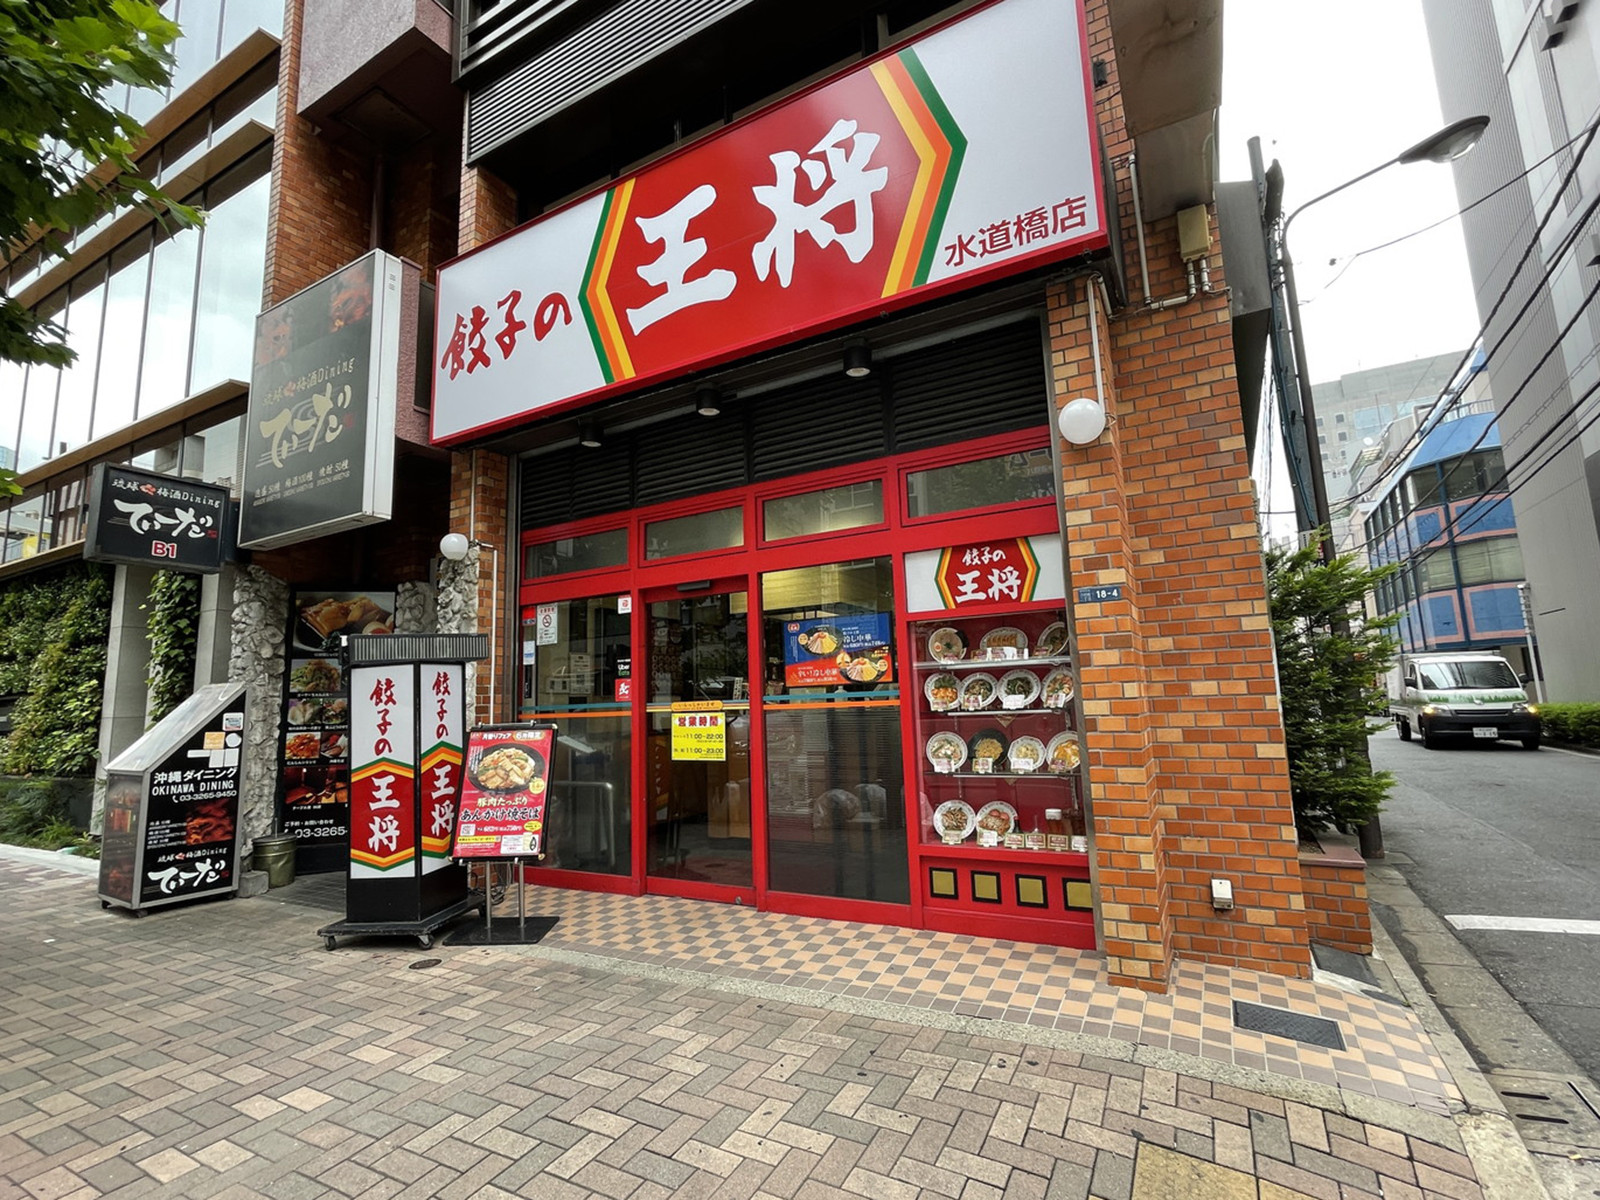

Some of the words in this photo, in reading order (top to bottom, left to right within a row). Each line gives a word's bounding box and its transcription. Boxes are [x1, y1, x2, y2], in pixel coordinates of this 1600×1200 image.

[944, 195, 1088, 268] 水道橋店
[441, 290, 572, 381] 餃子の
[626, 119, 889, 337] 王将
[113, 499, 213, 538] てぃーだ
[151, 540, 178, 559] B1
[962, 546, 1006, 567] 餃子の
[955, 565, 1022, 604] 王将
[1096, 588, 1119, 600] 18-4
[370, 678, 397, 756] 餃子の
[432, 671, 451, 739] 餃子の
[678, 716, 719, 727] 営業時間
[152, 783, 195, 796] OKINAWA
[199, 780, 234, 792] DINING
[179, 790, 237, 802] 03-3265-9450
[430, 764, 456, 836] 王将
[477, 796, 528, 807] 豚肉たっぷり
[284, 819, 334, 828] ご予約・お問い合わせ
[367, 774, 401, 852] 王将
[460, 806, 542, 821] あんかけ焼そば
[147, 858, 226, 893] てぃーだ
